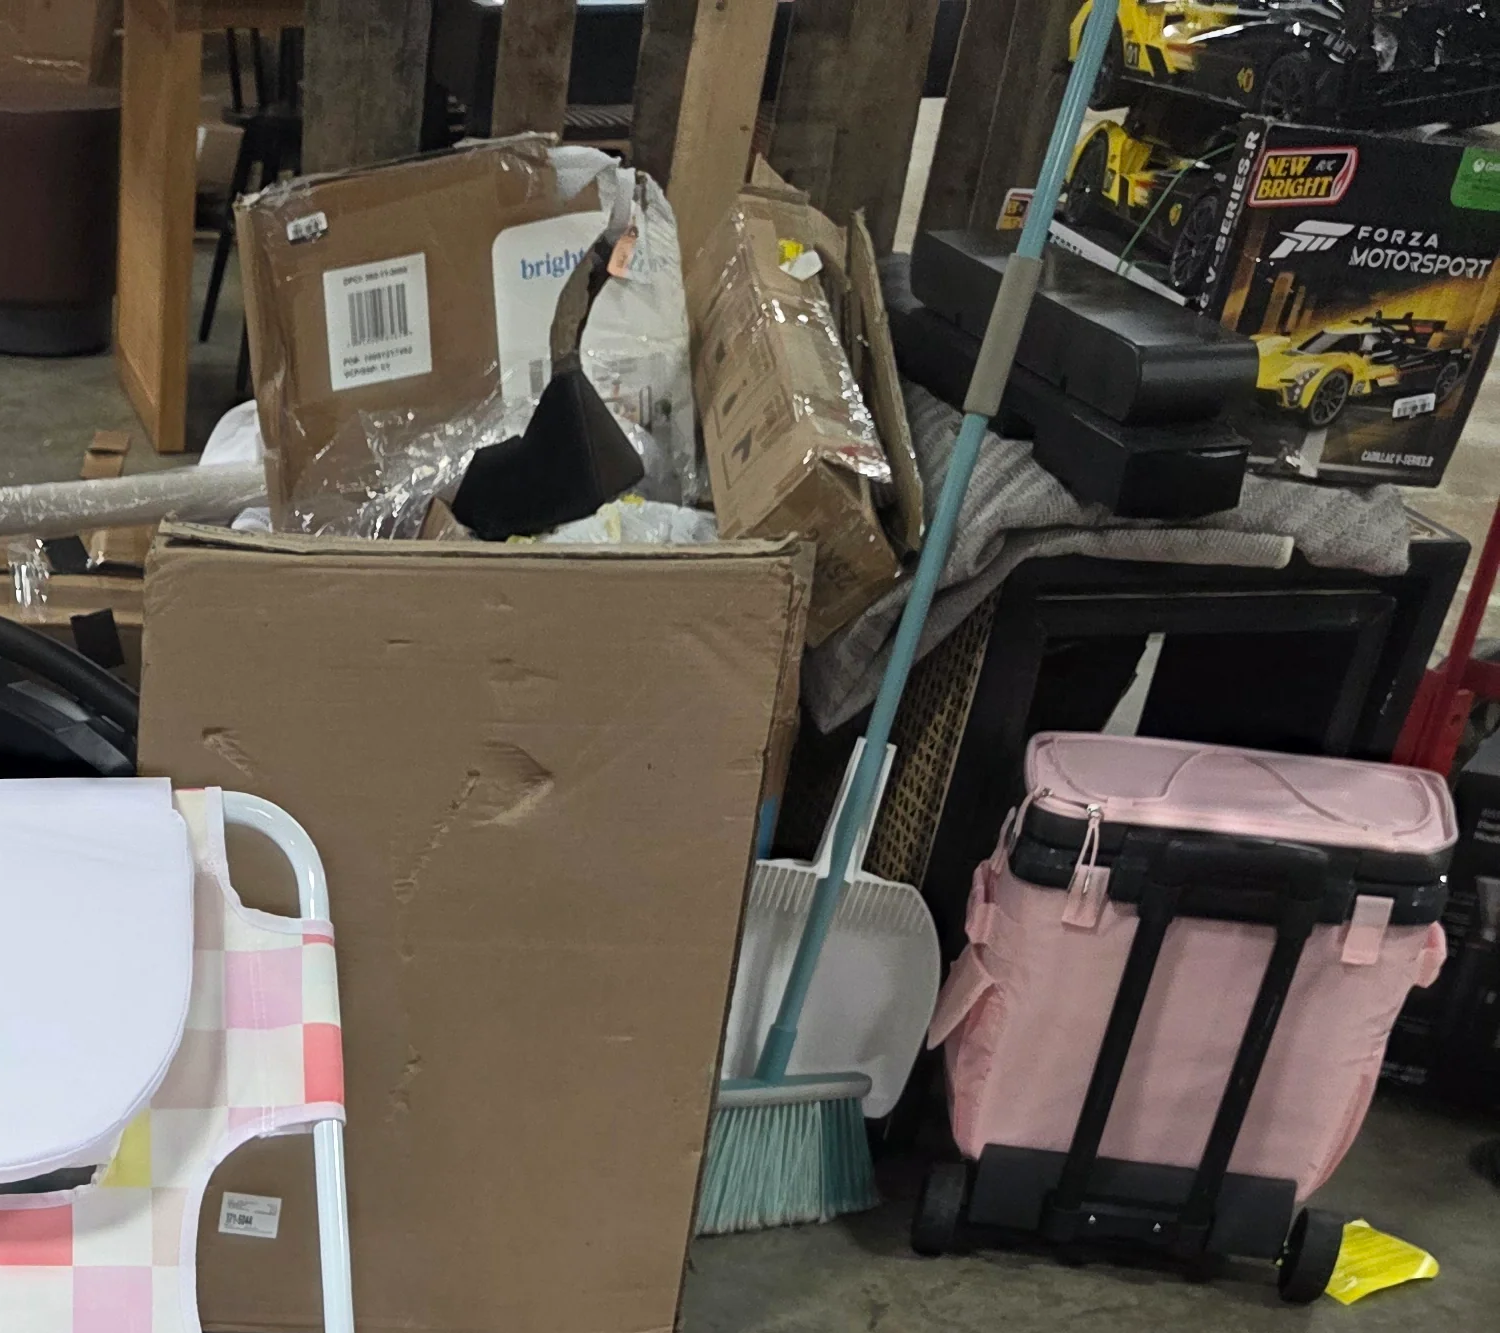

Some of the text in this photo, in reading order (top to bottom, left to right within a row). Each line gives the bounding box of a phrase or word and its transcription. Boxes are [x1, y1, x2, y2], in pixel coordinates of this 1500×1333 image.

[1264, 156, 1311, 176] NEW
[1257, 176, 1333, 198] BRIGHT
[1358, 226, 1438, 248] FORZA
[1348, 246, 1492, 280] MOTORSPORT
